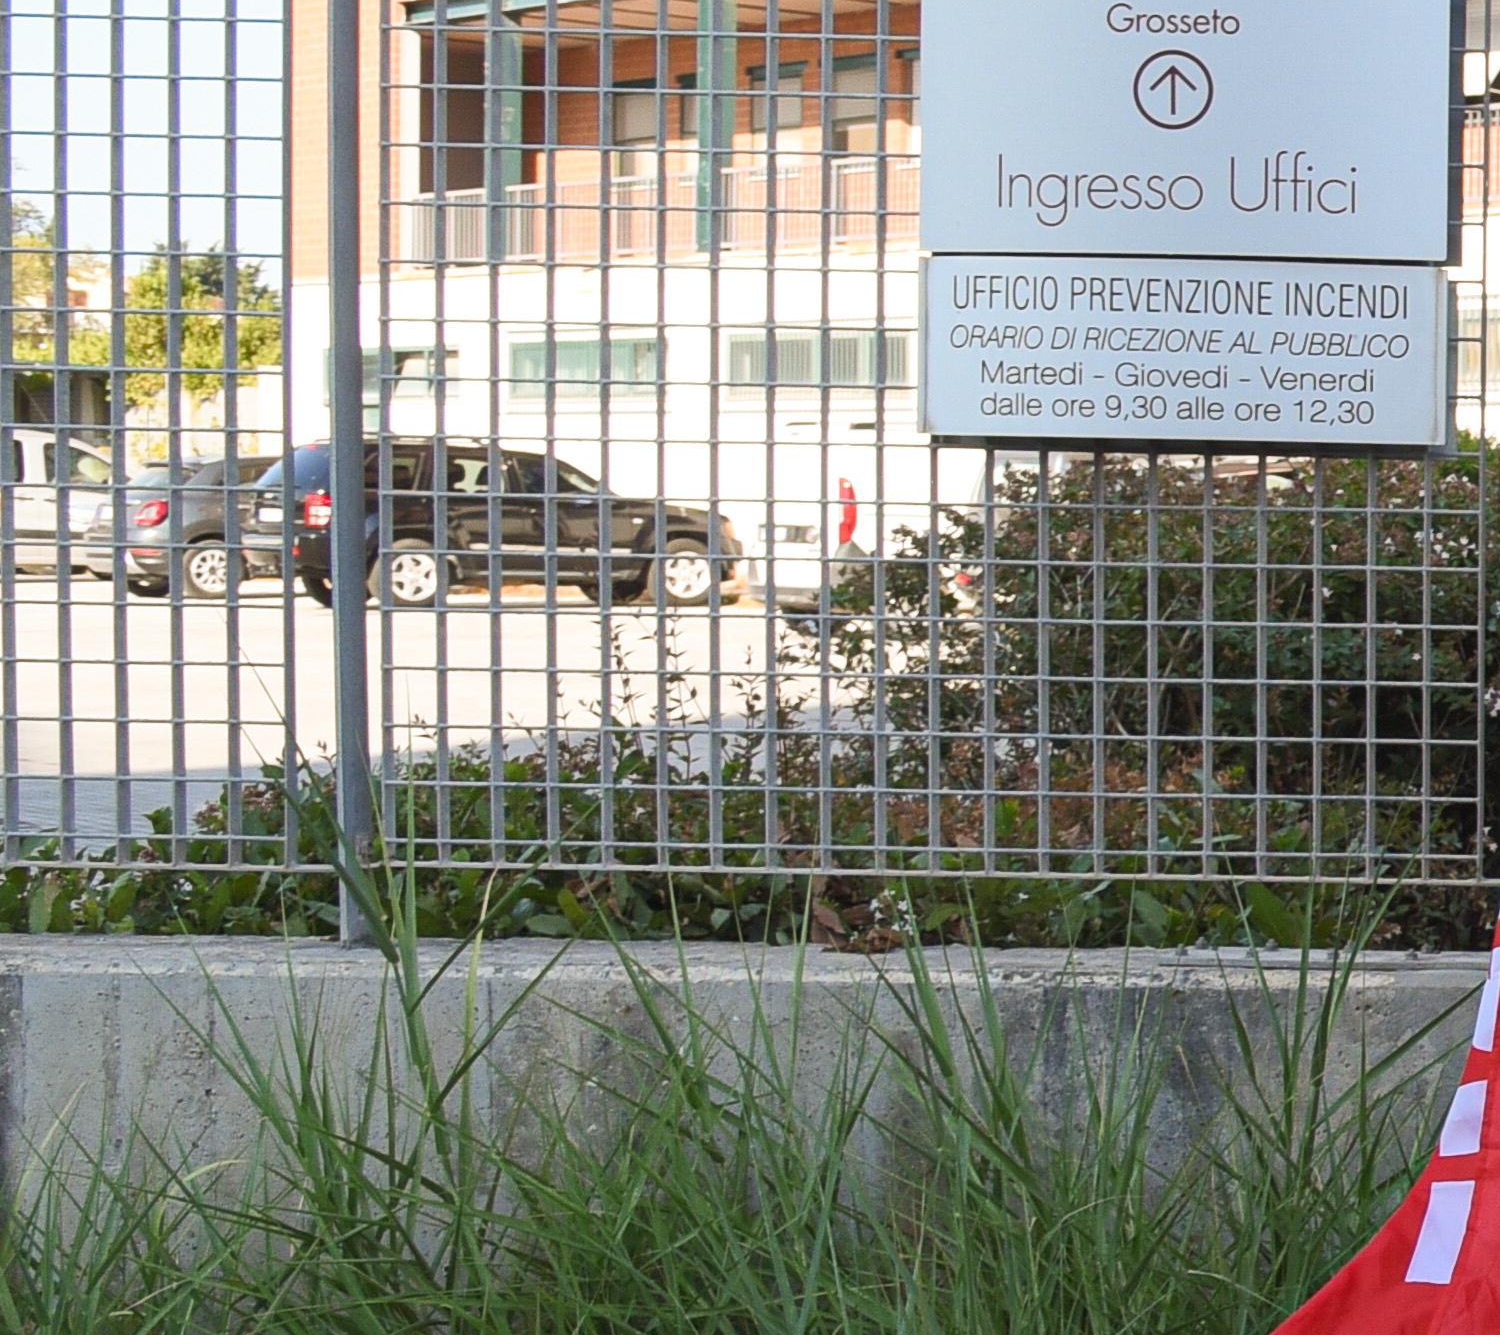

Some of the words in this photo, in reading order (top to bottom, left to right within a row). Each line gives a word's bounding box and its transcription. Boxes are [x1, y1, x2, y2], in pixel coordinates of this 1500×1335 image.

[1106, 2, 1241, 35] Grosseto
[998, 153, 1204, 227] Ingresso
[1230, 150, 1358, 214] Uffici
[952, 274, 1059, 311] UFFICIO
[1070, 277, 1274, 317] PREVENZIONE
[1284, 282, 1409, 321] INCENDI
[949, 324, 1045, 351] ORARIO
[1050, 327, 1078, 351] DI
[1084, 328, 1224, 354] RICEZIONE
[1228, 330, 1263, 355] AL
[1270, 332, 1410, 359] PUBBLICO
[980, 359, 1084, 387] Martedi
[1114, 362, 1229, 389] Giovedi
[1260, 366, 1376, 393] Venerdi
[980, 392, 1043, 417] dalle
[1051, 397, 1096, 419] ore
[1104, 394, 1168, 423] 9,30
[1176, 394, 1225, 421] alle
[1234, 401, 1281, 423] ore
[1292, 399, 1375, 426] 12,30
